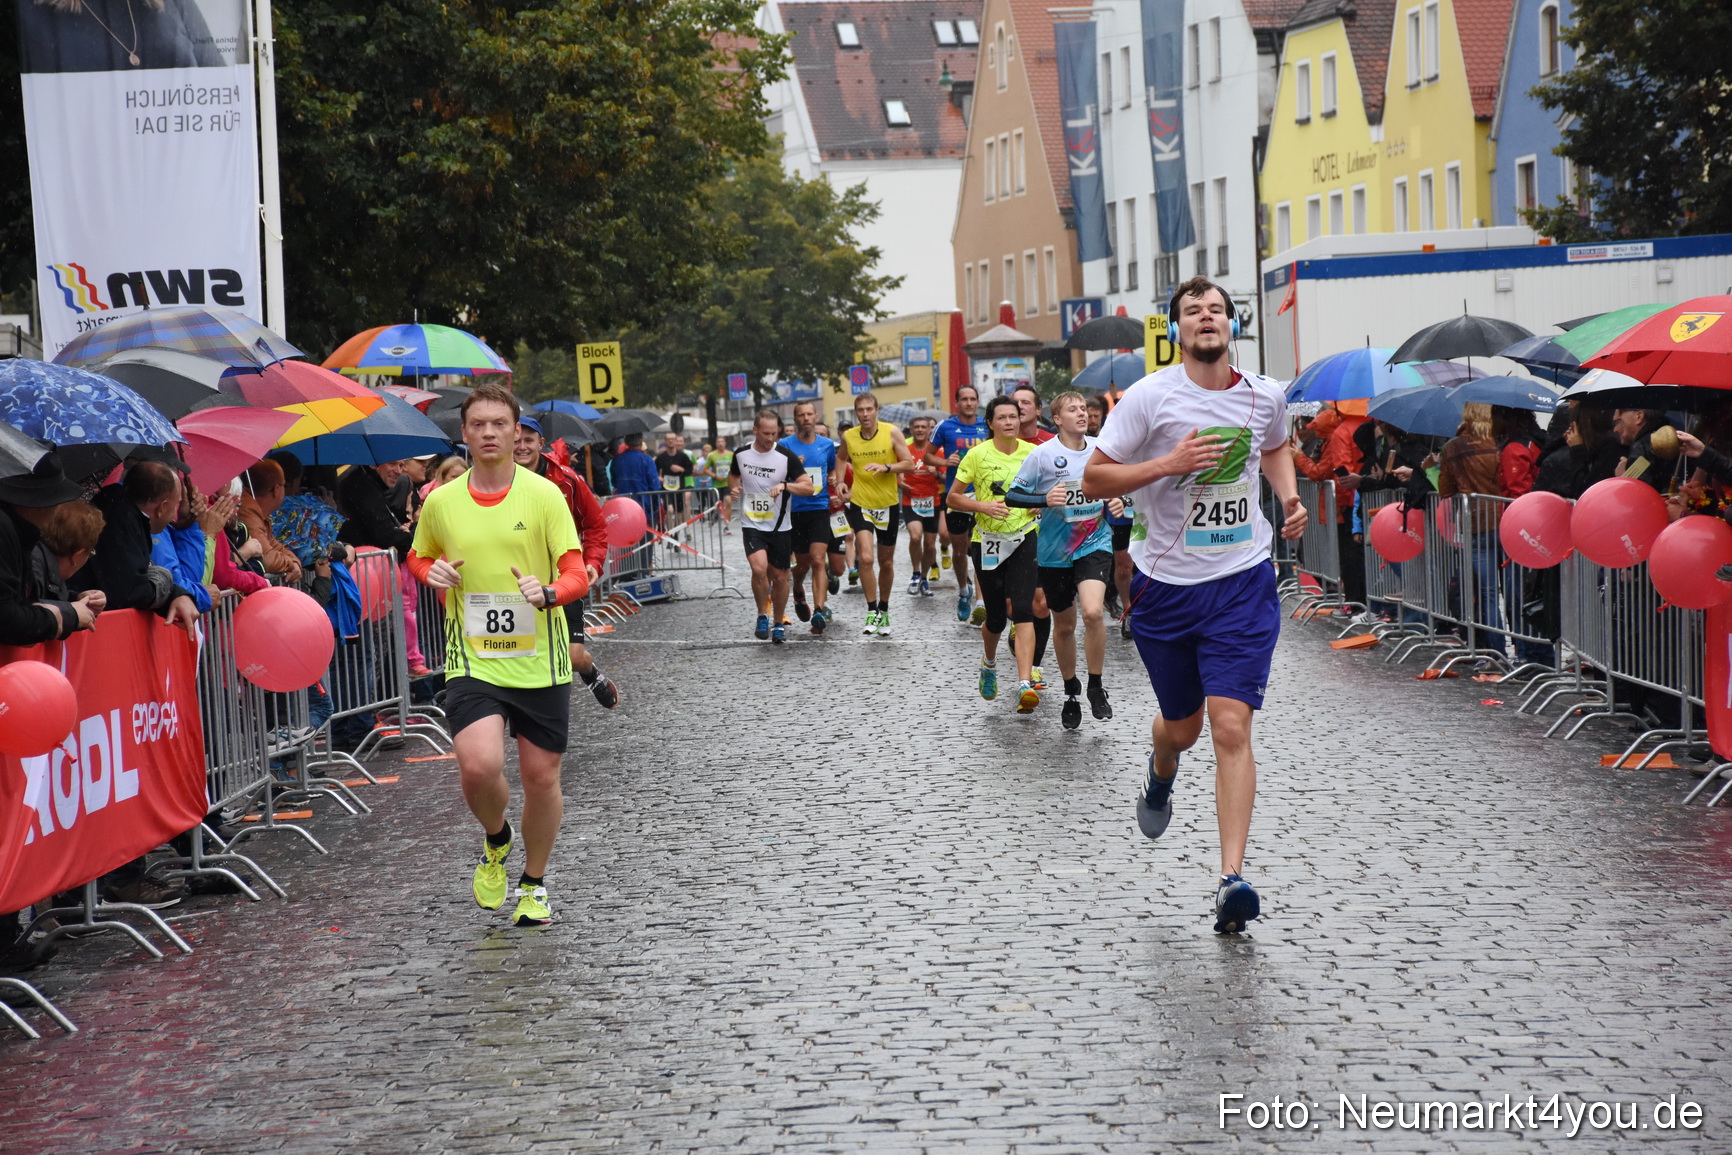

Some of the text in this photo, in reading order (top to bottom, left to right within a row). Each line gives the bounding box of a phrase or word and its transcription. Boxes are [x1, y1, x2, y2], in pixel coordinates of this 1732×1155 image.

[1312, 152, 1340, 184] HOTEL
[1150, 317, 1168, 329] Blo
[582, 345, 615, 358] Block
[1156, 334, 1175, 366] D
[590, 363, 612, 394] D
[853, 385, 869, 393] TAXI
[747, 464, 776, 473] INTERSPORT
[751, 500, 769, 512] 155
[1192, 497, 1248, 527] 2450
[1210, 533, 1234, 543] Marc
[486, 609, 515, 633] 83
[483, 640, 517, 649] Florian
